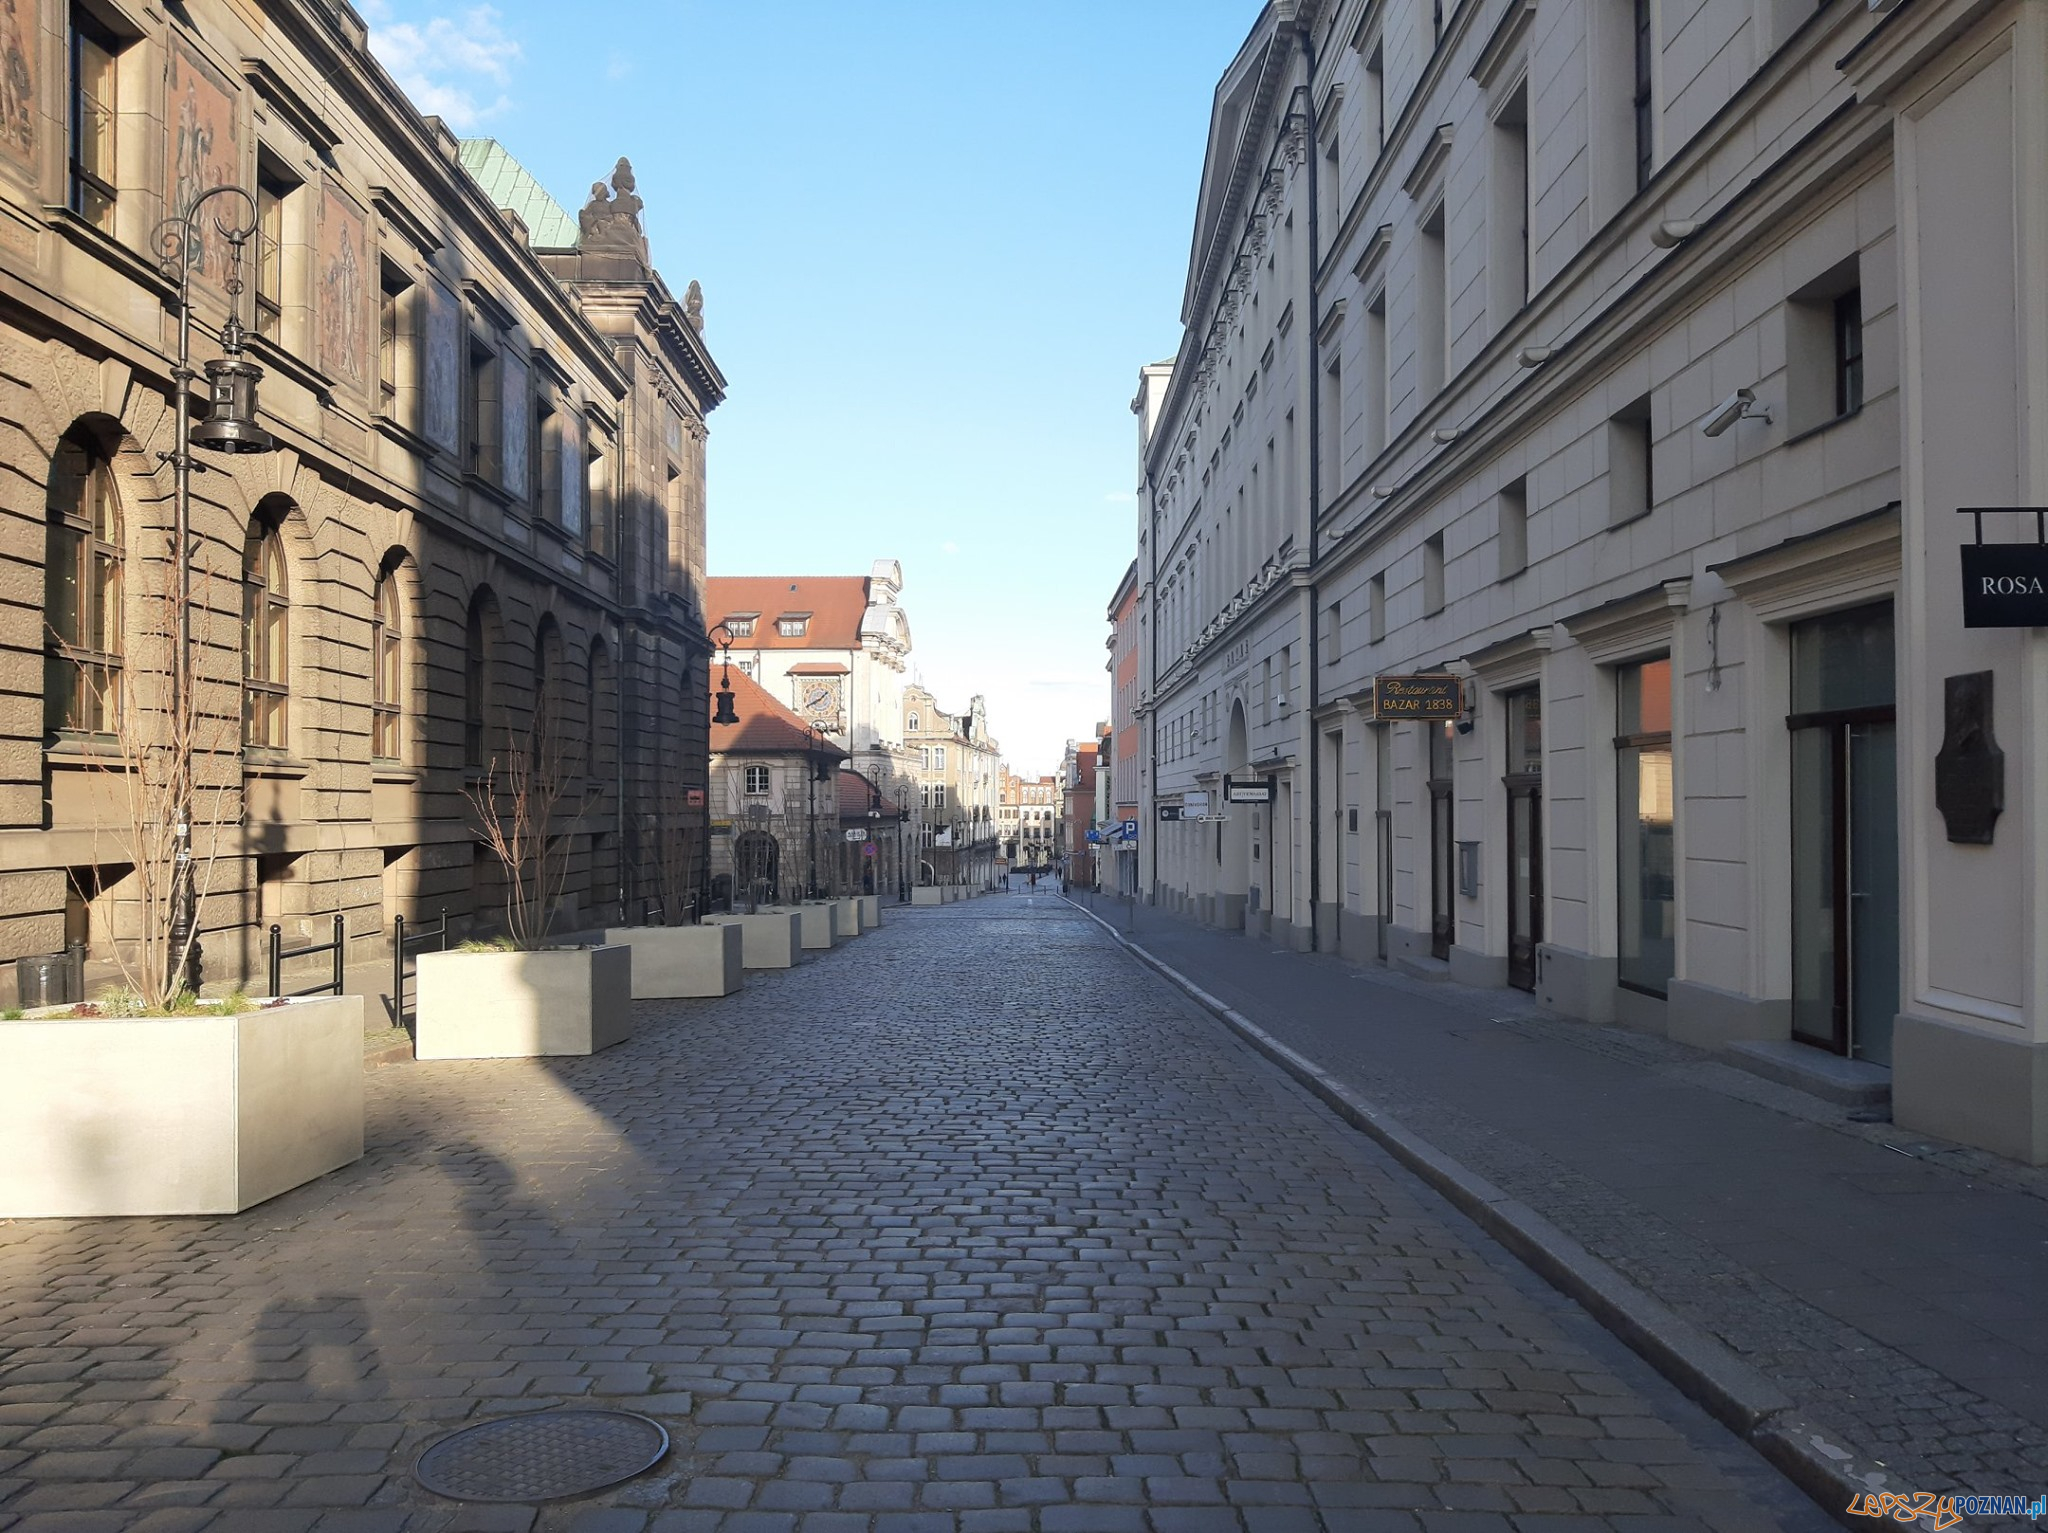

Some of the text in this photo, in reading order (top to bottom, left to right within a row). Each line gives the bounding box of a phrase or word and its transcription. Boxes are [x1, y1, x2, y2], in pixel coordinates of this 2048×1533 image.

[1981, 576, 2044, 595] ROSA
[1386, 681, 1448, 696] Restaurant
[1383, 698, 1453, 710] BAZAR 1838
[1125, 822, 1136, 835] P
